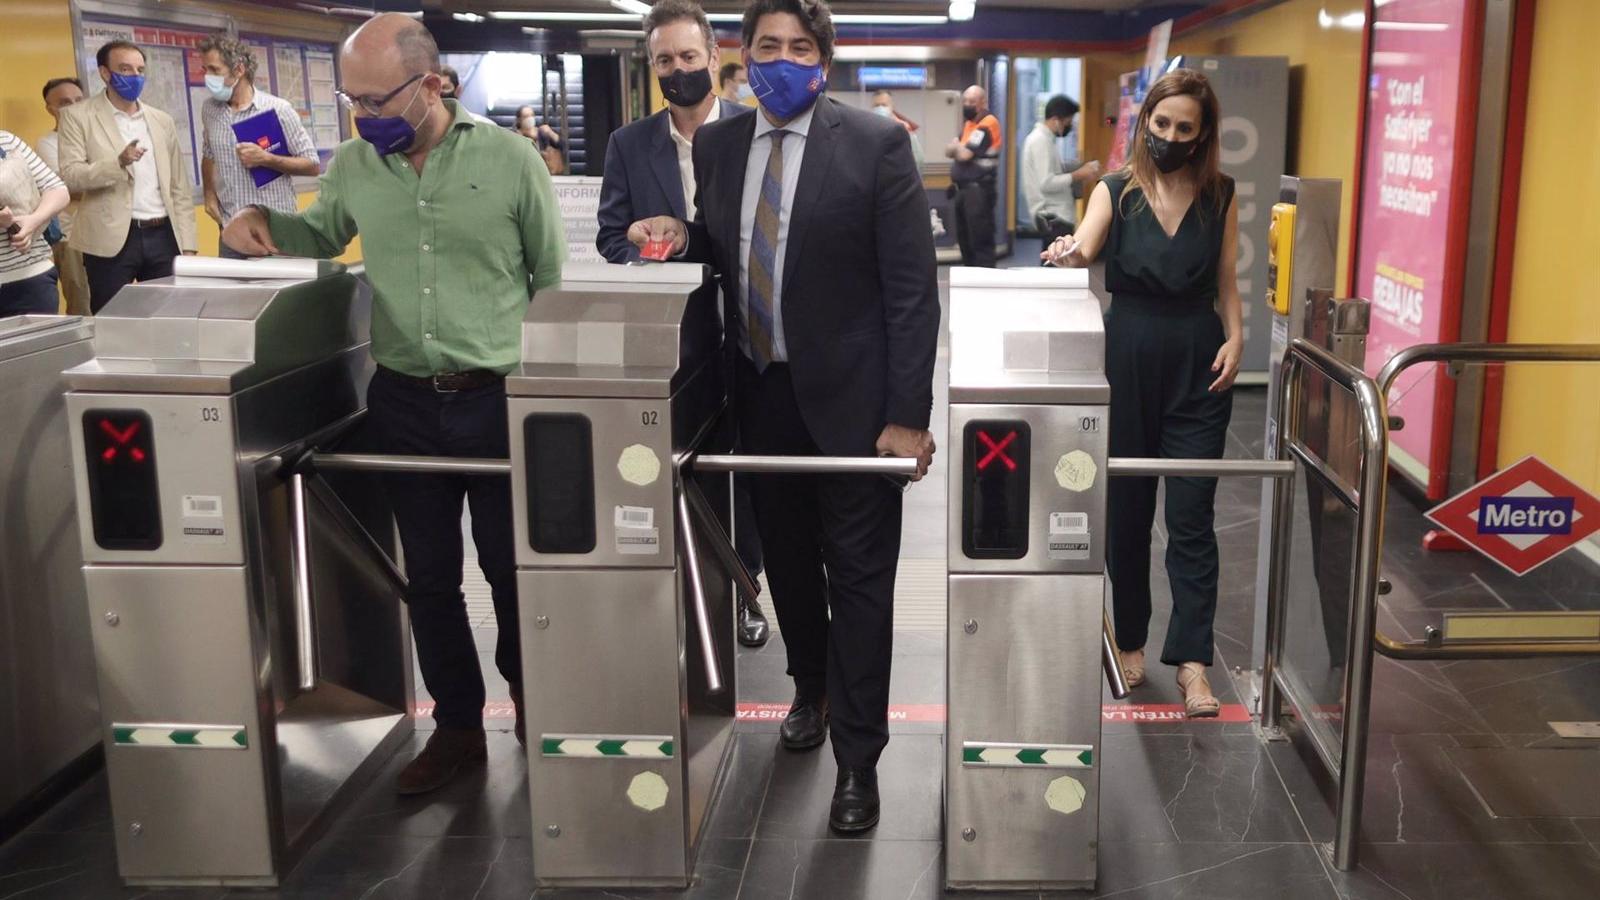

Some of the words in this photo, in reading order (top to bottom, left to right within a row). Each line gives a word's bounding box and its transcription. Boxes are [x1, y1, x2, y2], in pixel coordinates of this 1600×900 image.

[1411, 153, 1433, 180] nos
[1373, 274, 1424, 325] REBAJAS
[203, 407, 219, 421] 03
[642, 410, 658, 425] 02
[1082, 416, 1096, 431] 01
[1484, 503, 1566, 528] Metro
[1101, 710, 1127, 720] LA
[1132, 710, 1186, 720] NTÉN
